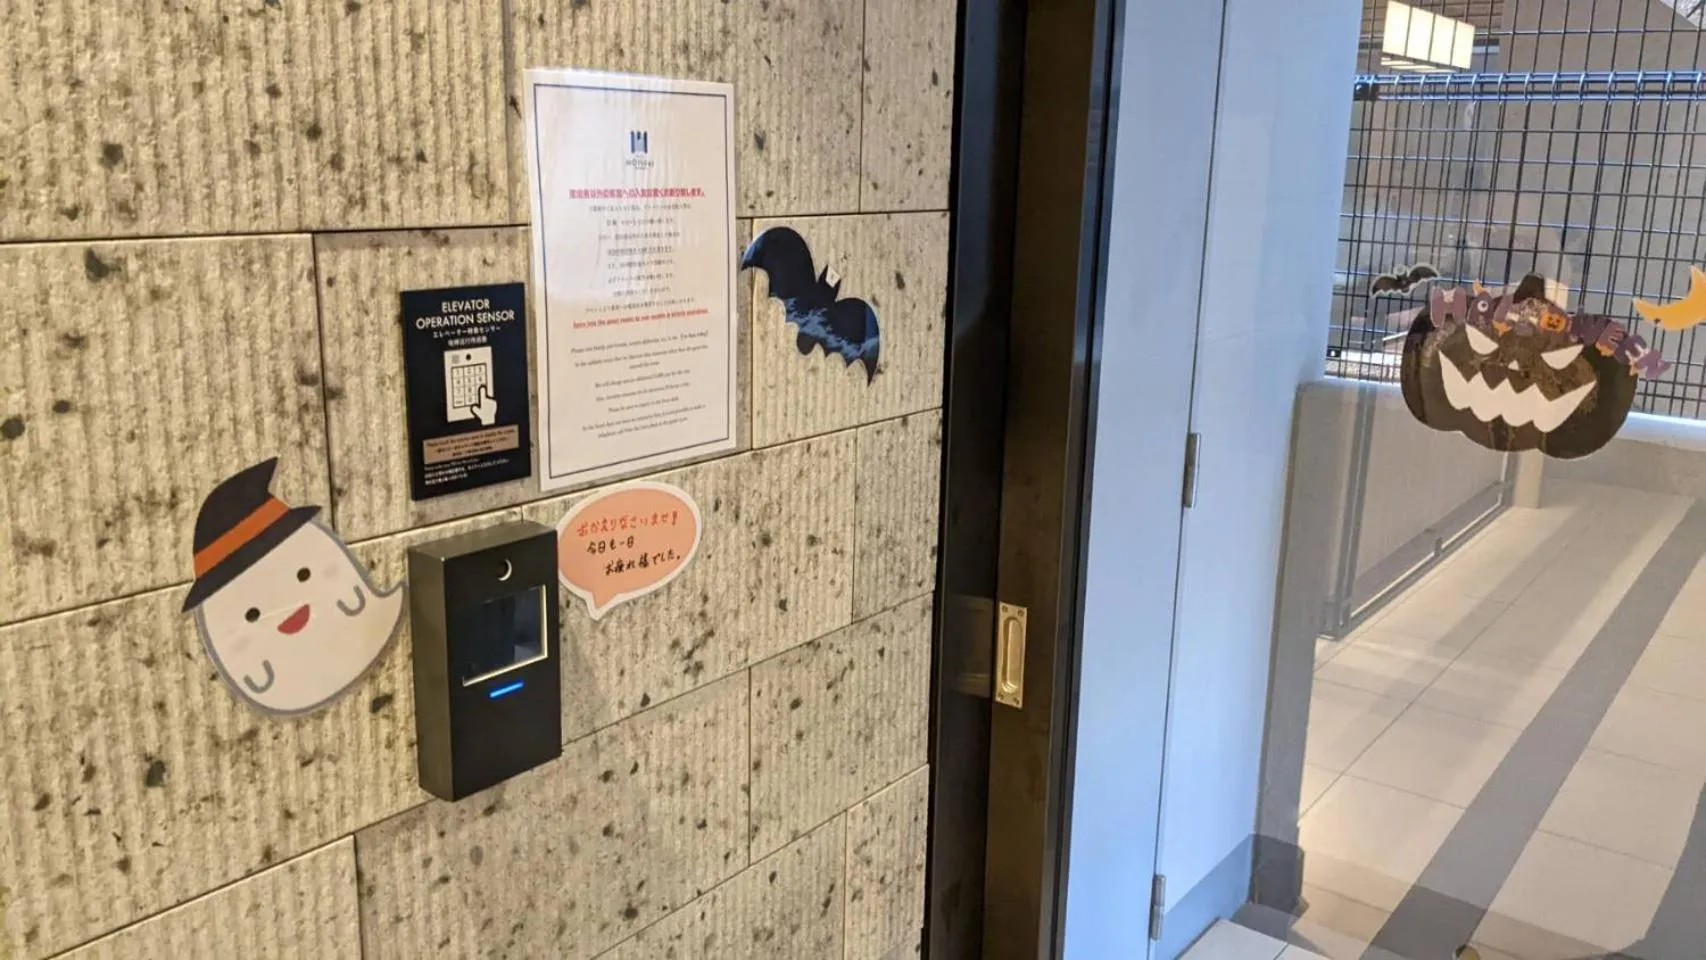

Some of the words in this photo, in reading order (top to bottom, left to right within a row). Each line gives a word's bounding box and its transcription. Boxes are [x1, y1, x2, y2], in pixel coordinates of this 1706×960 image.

[441, 298, 490, 313] ELEVATOR
[415, 314, 474, 330] OPERATION
[477, 309, 515, 324] SENSOR
[587, 535, 635, 554] 今日も一日
[605, 548, 681, 576] お疲れ様でした。
